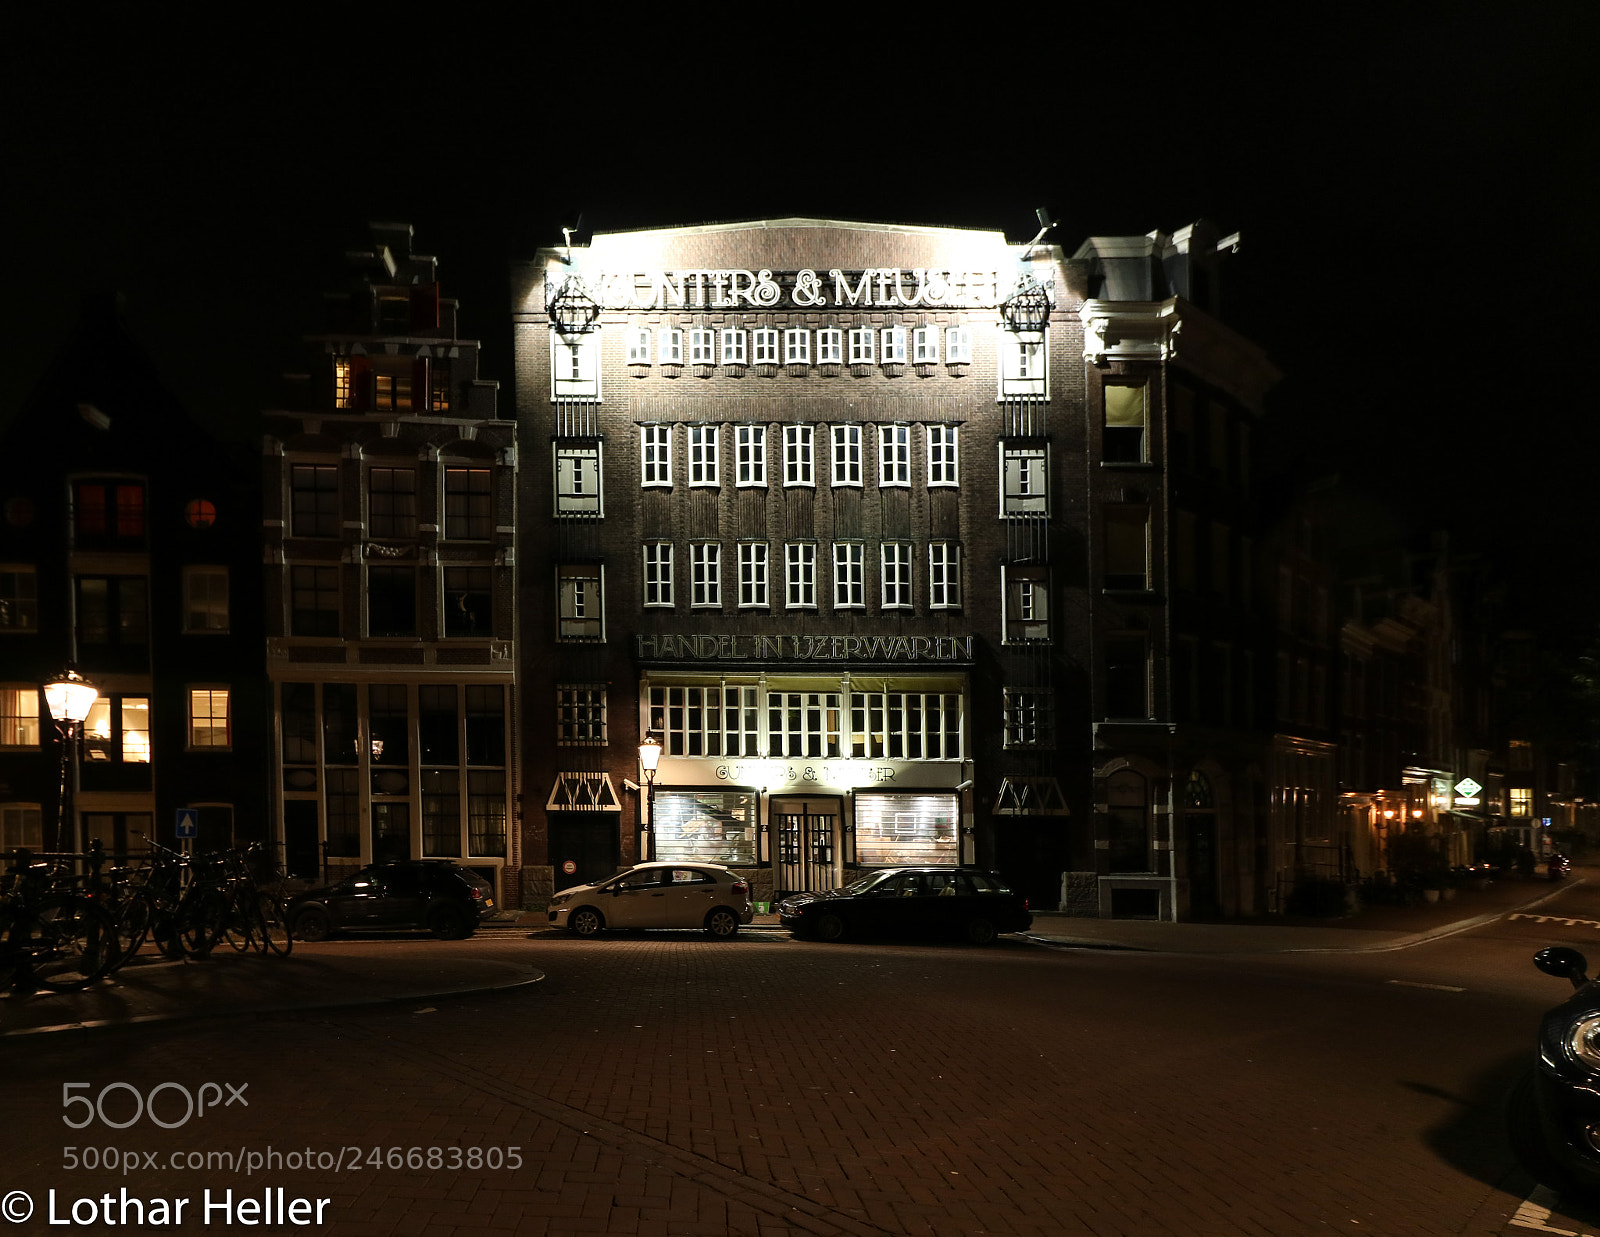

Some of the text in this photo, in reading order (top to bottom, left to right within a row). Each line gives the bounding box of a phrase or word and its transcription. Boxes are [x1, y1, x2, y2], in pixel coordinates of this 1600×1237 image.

[792, 269, 827, 309] &
[636, 633, 974, 660] HANDEL IN IJZERWAREN
[803, 766, 818, 781] &
